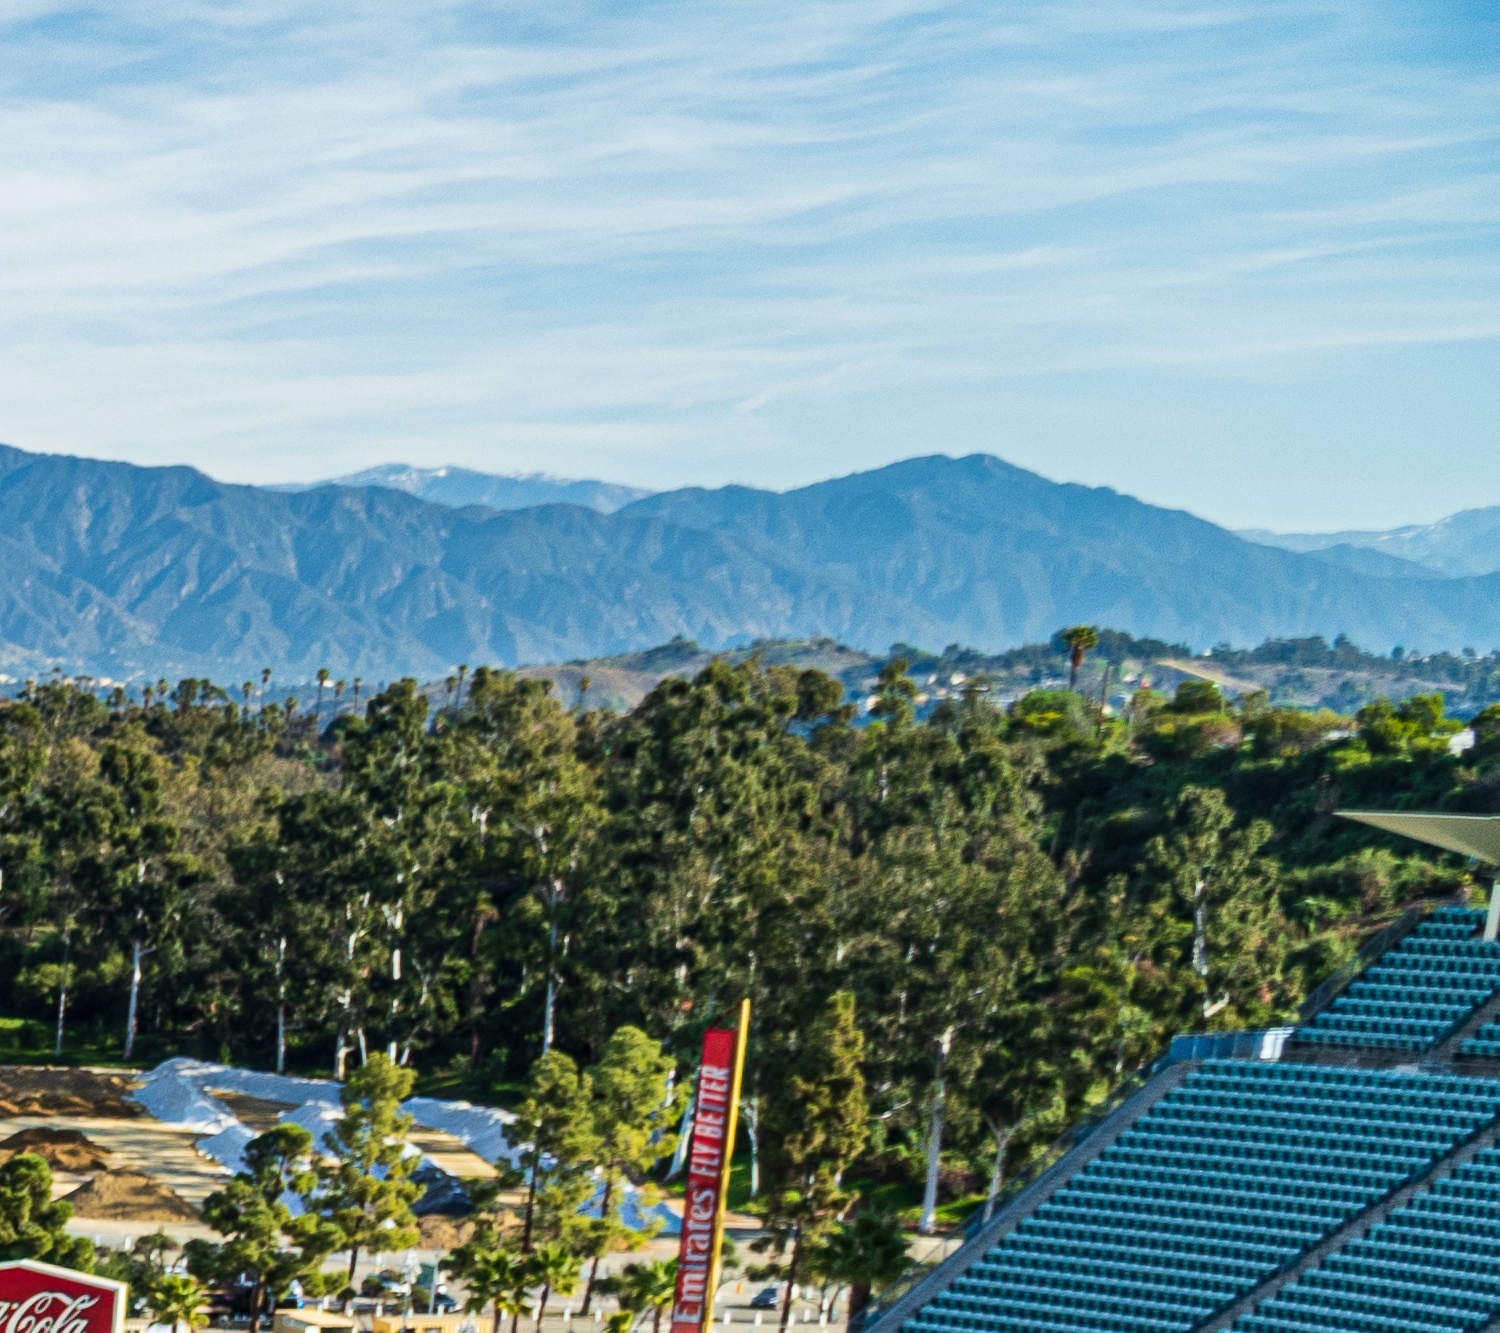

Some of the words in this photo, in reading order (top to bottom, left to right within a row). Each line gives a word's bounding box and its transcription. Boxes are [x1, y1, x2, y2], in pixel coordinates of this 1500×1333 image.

[695, 1064, 731, 1137] BETTER
[690, 1145, 721, 1178] FLY
[674, 1188, 716, 1323] Emirates
